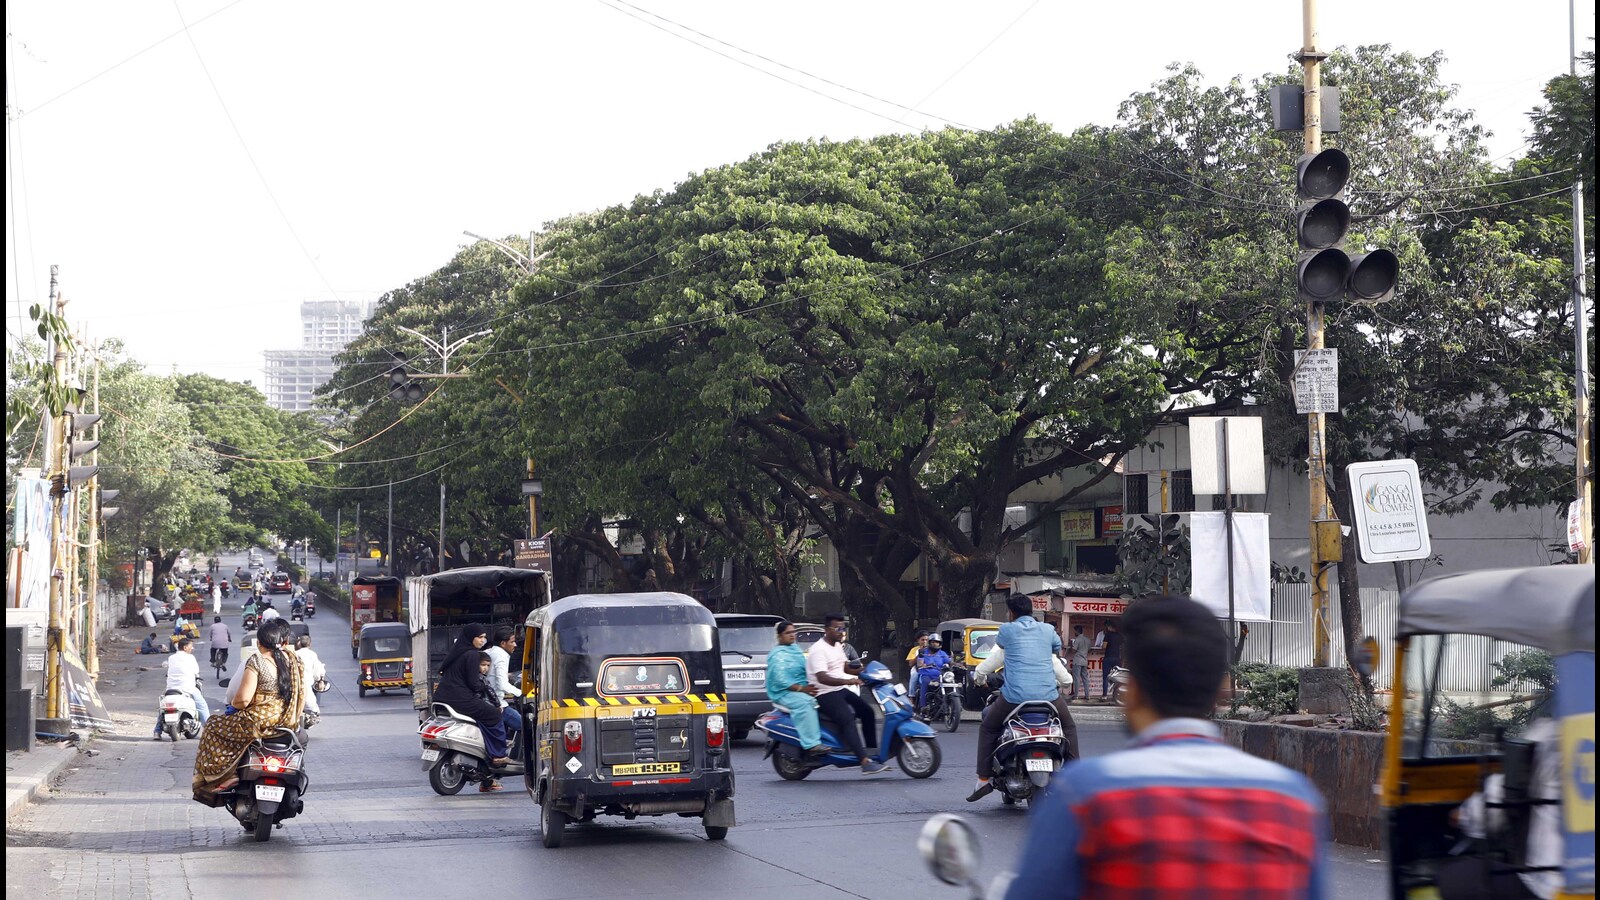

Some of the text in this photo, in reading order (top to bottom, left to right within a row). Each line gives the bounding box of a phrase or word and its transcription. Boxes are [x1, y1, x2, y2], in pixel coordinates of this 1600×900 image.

[1377, 485, 1410, 495] GANGA
[1379, 492, 1412, 505] DHAM
[1381, 503, 1414, 513] TOWERS
[1072, 601, 1109, 613] रुद्रायन
[632, 707, 657, 718] TVS
[639, 763, 679, 774] 1932
